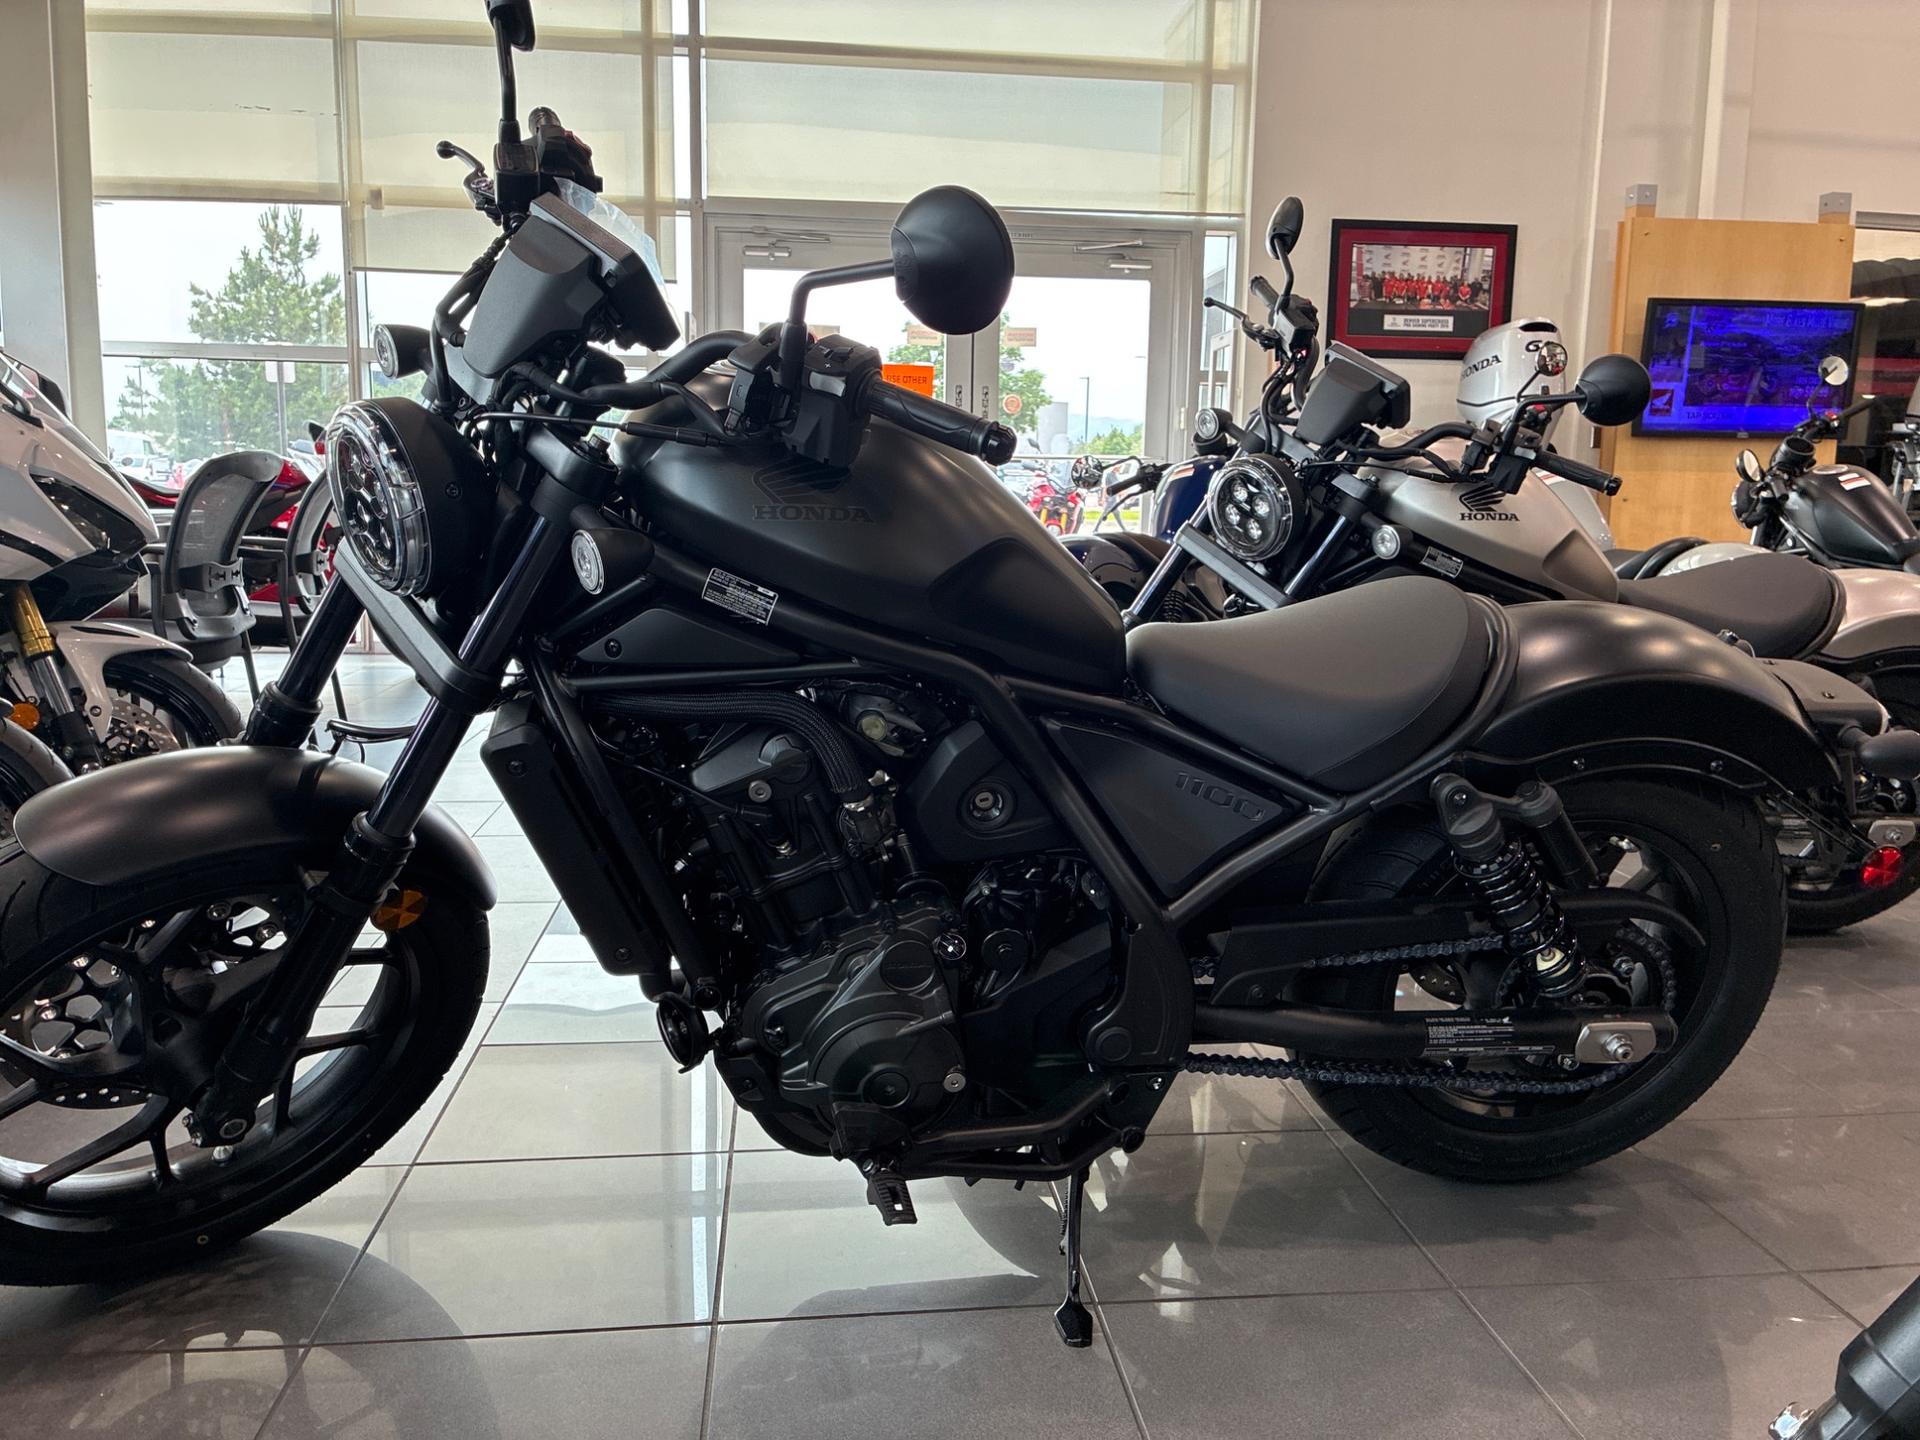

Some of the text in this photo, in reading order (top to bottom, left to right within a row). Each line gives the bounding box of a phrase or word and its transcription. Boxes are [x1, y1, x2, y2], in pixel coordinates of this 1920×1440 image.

[902, 375, 927, 385] OTHER
[752, 504, 874, 523] HONDA
[1459, 512, 1520, 522] HONDA
[1175, 771, 1265, 821] 1100
